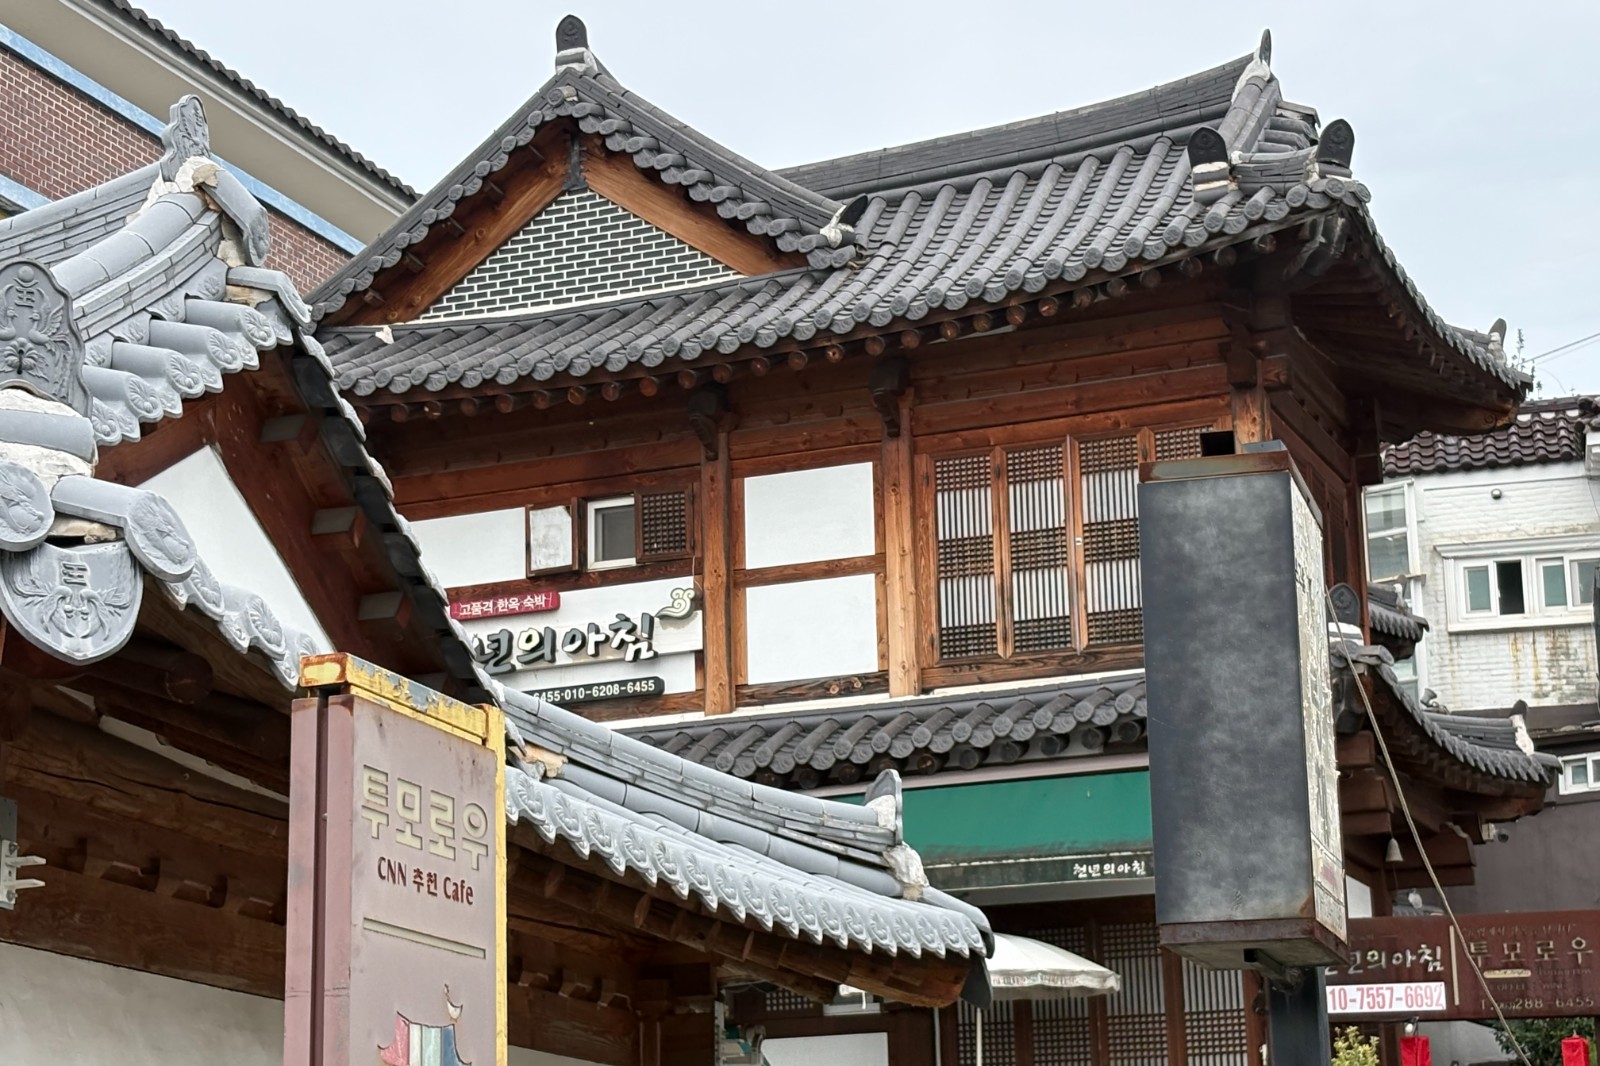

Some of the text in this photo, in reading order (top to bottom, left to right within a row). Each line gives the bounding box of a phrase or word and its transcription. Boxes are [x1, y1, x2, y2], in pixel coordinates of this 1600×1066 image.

[459, 593, 546, 616] 고품격 한옥 숙박
[360, 763, 489, 871] 투모로우
[377, 856, 475, 907] CNN 추천 Cafe
[1073, 860, 1147, 878] 천년의아침
[1324, 943, 1445, 976] 년의아침
[1328, 984, 1443, 1011] 10-7557-6692
